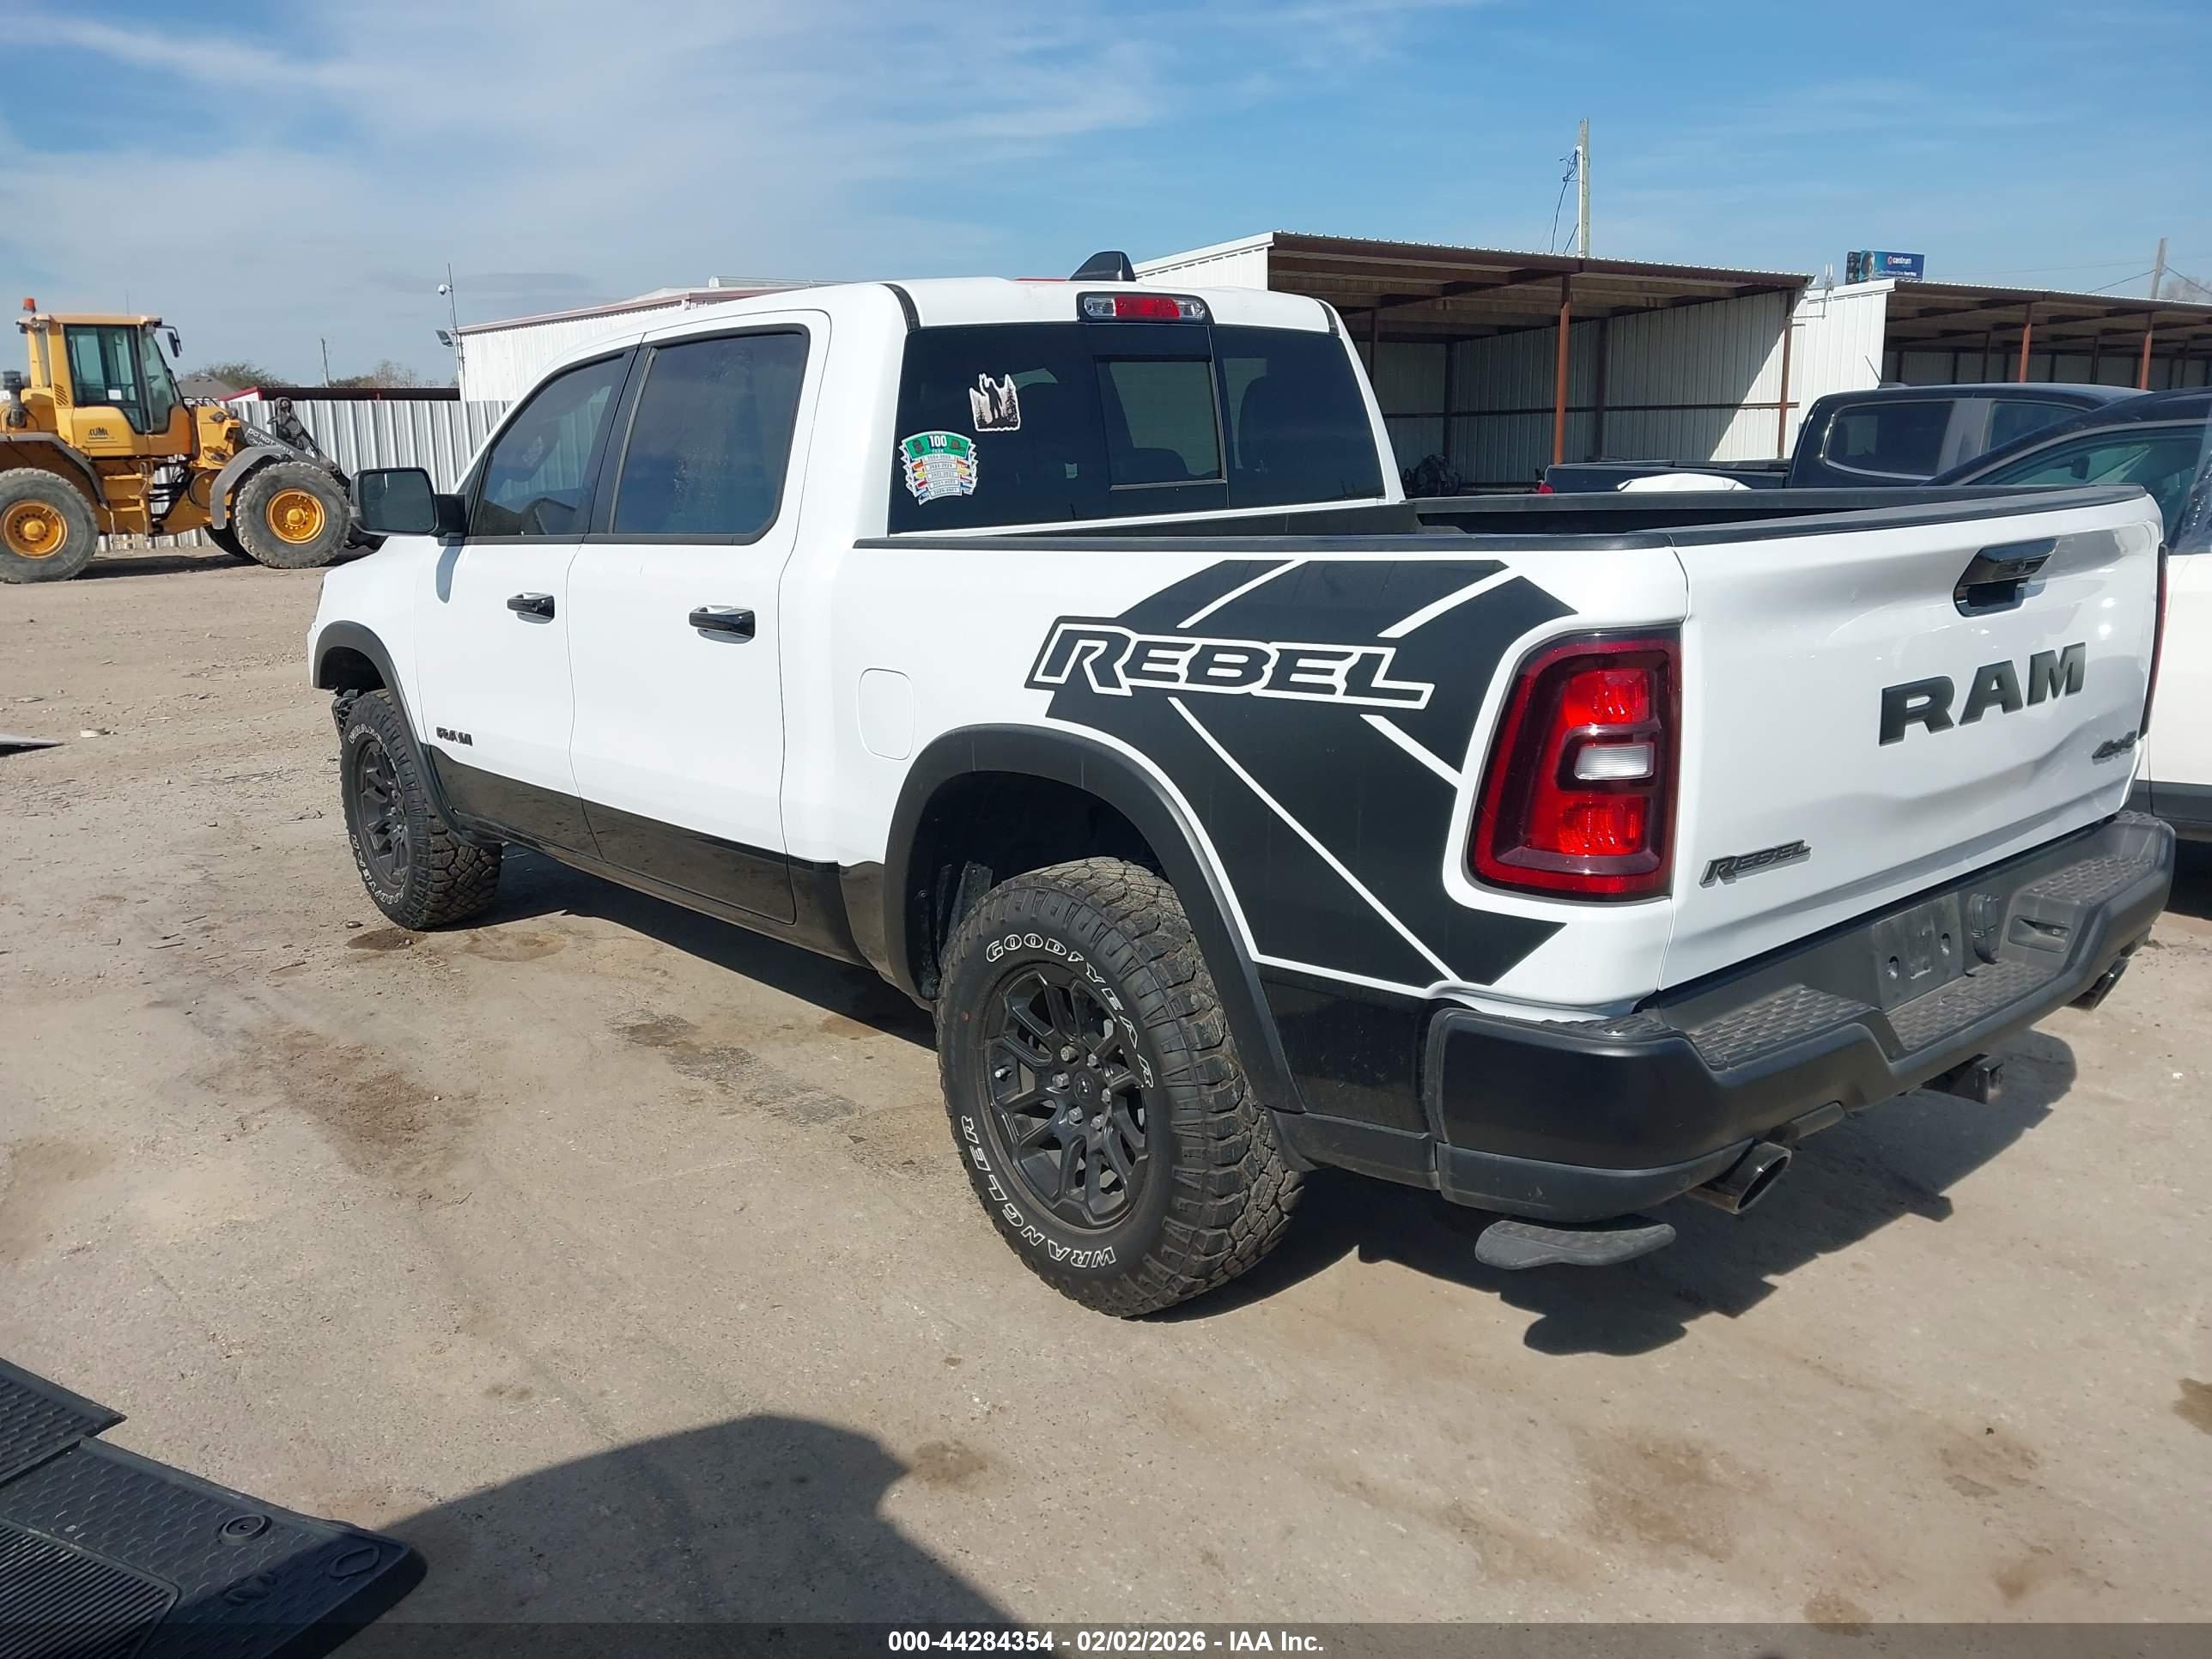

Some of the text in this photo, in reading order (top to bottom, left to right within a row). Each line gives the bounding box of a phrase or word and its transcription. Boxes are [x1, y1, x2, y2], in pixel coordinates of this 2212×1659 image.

[259, 434, 275, 446] NOT
[928, 435, 947, 447] 100
[1032, 622, 1436, 710] REBEL
[1878, 641, 2087, 747] RAM
[435, 726, 473, 746] RAM
[1699, 839, 1812, 888] REBEL
[985, 933, 1156, 1089] GOODYEAR
[961, 1115, 1118, 1269] WRANGLER
